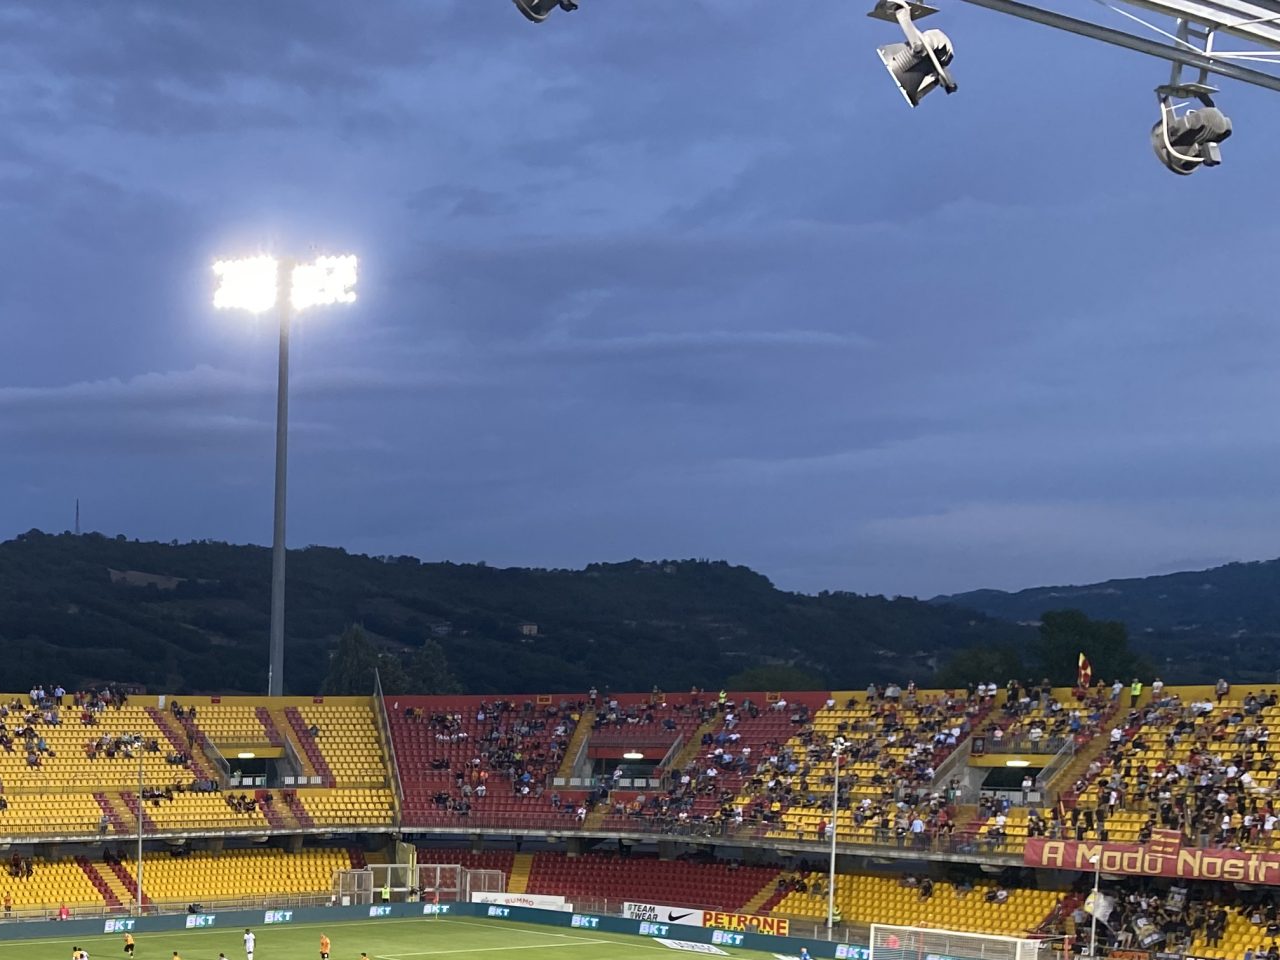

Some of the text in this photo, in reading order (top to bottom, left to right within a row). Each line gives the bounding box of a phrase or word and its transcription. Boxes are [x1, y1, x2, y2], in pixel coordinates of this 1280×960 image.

[1041, 841, 1065, 867] A
[1075, 843, 1162, 874] Modo
[632, 904, 656, 914] TEAM
[186, 914, 216, 929] BKT
[264, 910, 293, 924] BKT
[571, 914, 599, 928] BKT
[634, 912, 659, 922] WEAR
[703, 911, 789, 937] PETRONE
[104, 918, 135, 934] BKT
[639, 921, 669, 936] BKT
[712, 929, 744, 946] BKT
